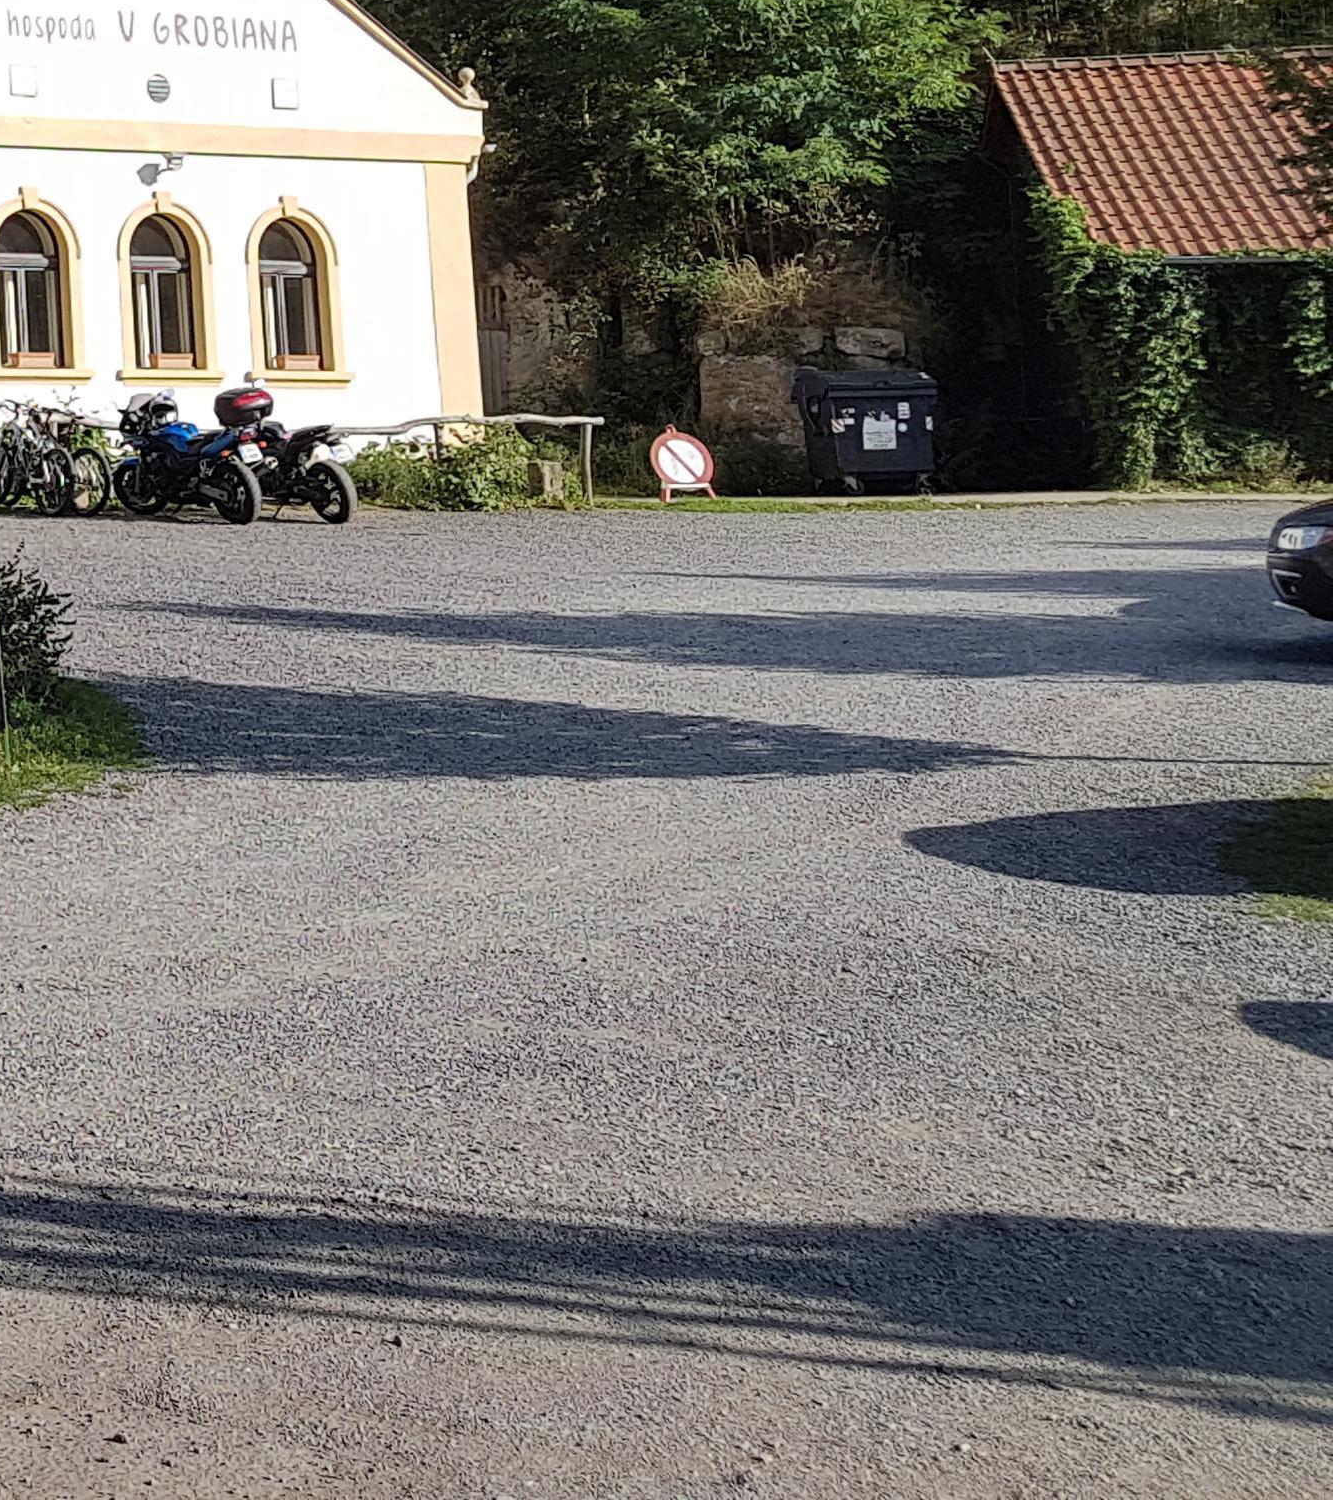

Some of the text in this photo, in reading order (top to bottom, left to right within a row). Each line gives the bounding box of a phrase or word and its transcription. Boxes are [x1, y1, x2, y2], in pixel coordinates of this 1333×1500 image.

[7, 9, 297, 52] hospoda V GROBIANA
